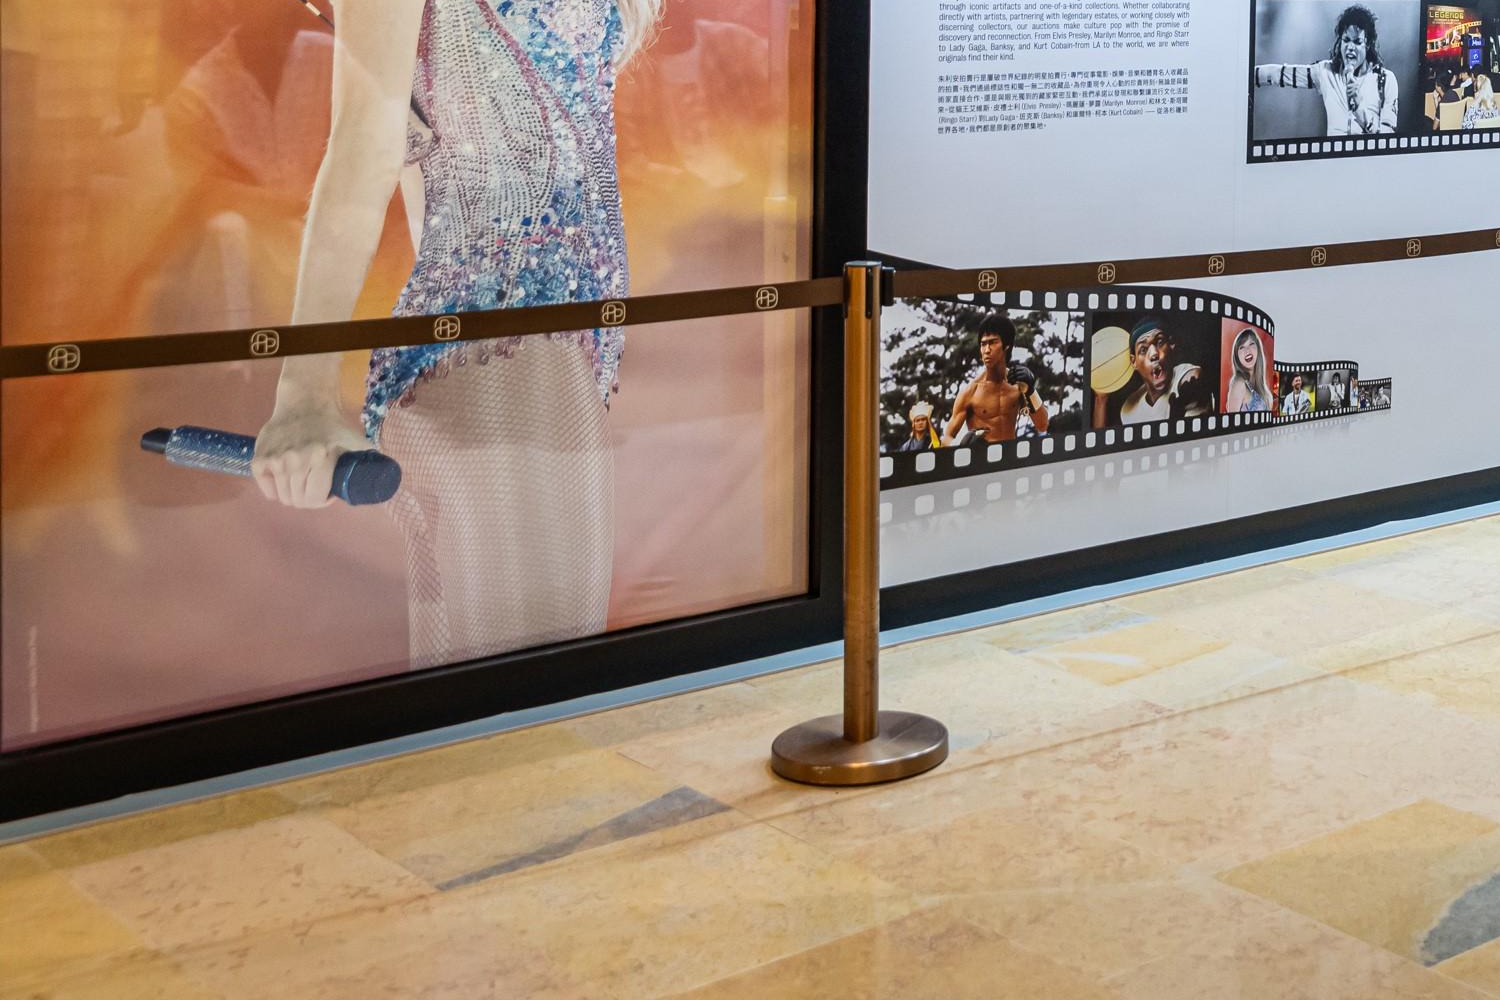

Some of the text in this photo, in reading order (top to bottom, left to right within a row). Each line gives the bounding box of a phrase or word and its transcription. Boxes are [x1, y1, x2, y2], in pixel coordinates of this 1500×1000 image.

[939, 3, 966, 12] through
[1151, 2, 1190, 11] collaborating
[939, 13, 964, 22] directly
[1009, 13, 1044, 21] partnering
[1062, 13, 1092, 21] legendary
[1130, 12, 1153, 20] working
[1154, 12, 1175, 20] closely
[939, 24, 974, 33] discerning
[1156, 22, 1180, 30] promise
[939, 34, 971, 43] discovery
[1094, 32, 1116, 40] Marilyn
[1156, 31, 1173, 39] Ringo
[949, 44, 965, 52] Lady
[939, 54, 966, 63] originals
